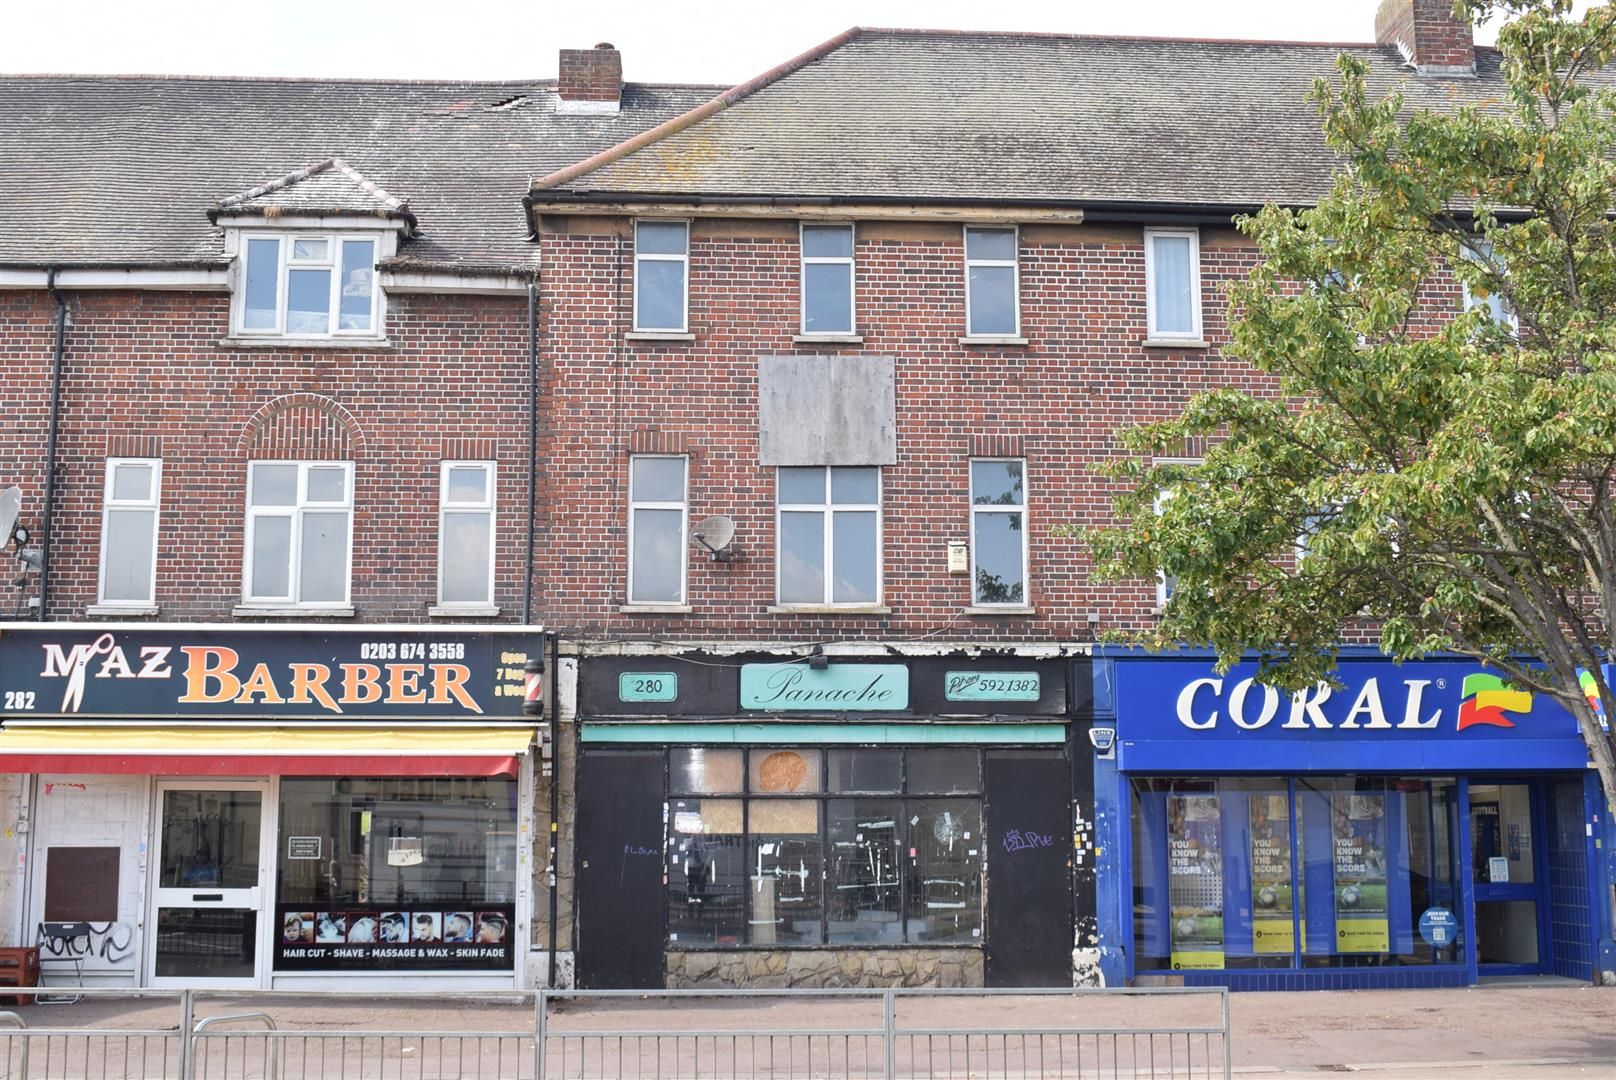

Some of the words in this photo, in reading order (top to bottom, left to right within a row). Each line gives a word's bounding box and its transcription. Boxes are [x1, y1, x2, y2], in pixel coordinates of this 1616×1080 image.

[361, 643, 396, 659] 0203
[400, 643, 425, 659] 674
[429, 643, 464, 659] 3558
[501, 652, 527, 664] Open
[496, 668, 504, 680] 7
[505, 668, 526, 680] Day
[178, 646, 484, 714] BARBER
[754, 667, 895, 703] Panache
[503, 684, 528, 696] Wee
[635, 680, 662, 693] 280
[4, 691, 35, 710] 282
[1176, 677, 1442, 729] CORAL
[1172, 840, 1189, 849] YOU
[1254, 839, 1271, 847] YOU
[1336, 839, 1353, 847] YOU
[1172, 849, 1198, 857] KNOW
[1254, 848, 1280, 856] KNOW
[1336, 847, 1362, 855] KNOW
[1172, 858, 1189, 866] THE
[1172, 866, 1201, 874] SCORE
[1336, 864, 1365, 872] SCORE
[283, 948, 306, 958] HAIR
[307, 948, 326, 958] CUT
[333, 948, 364, 958] SHAVE
[372, 948, 416, 958] MASSAGE
[418, 948, 425, 958] &
[427, 948, 448, 958] WAX
[456, 948, 478, 958] SKIN
[480, 948, 505, 958] FADE
